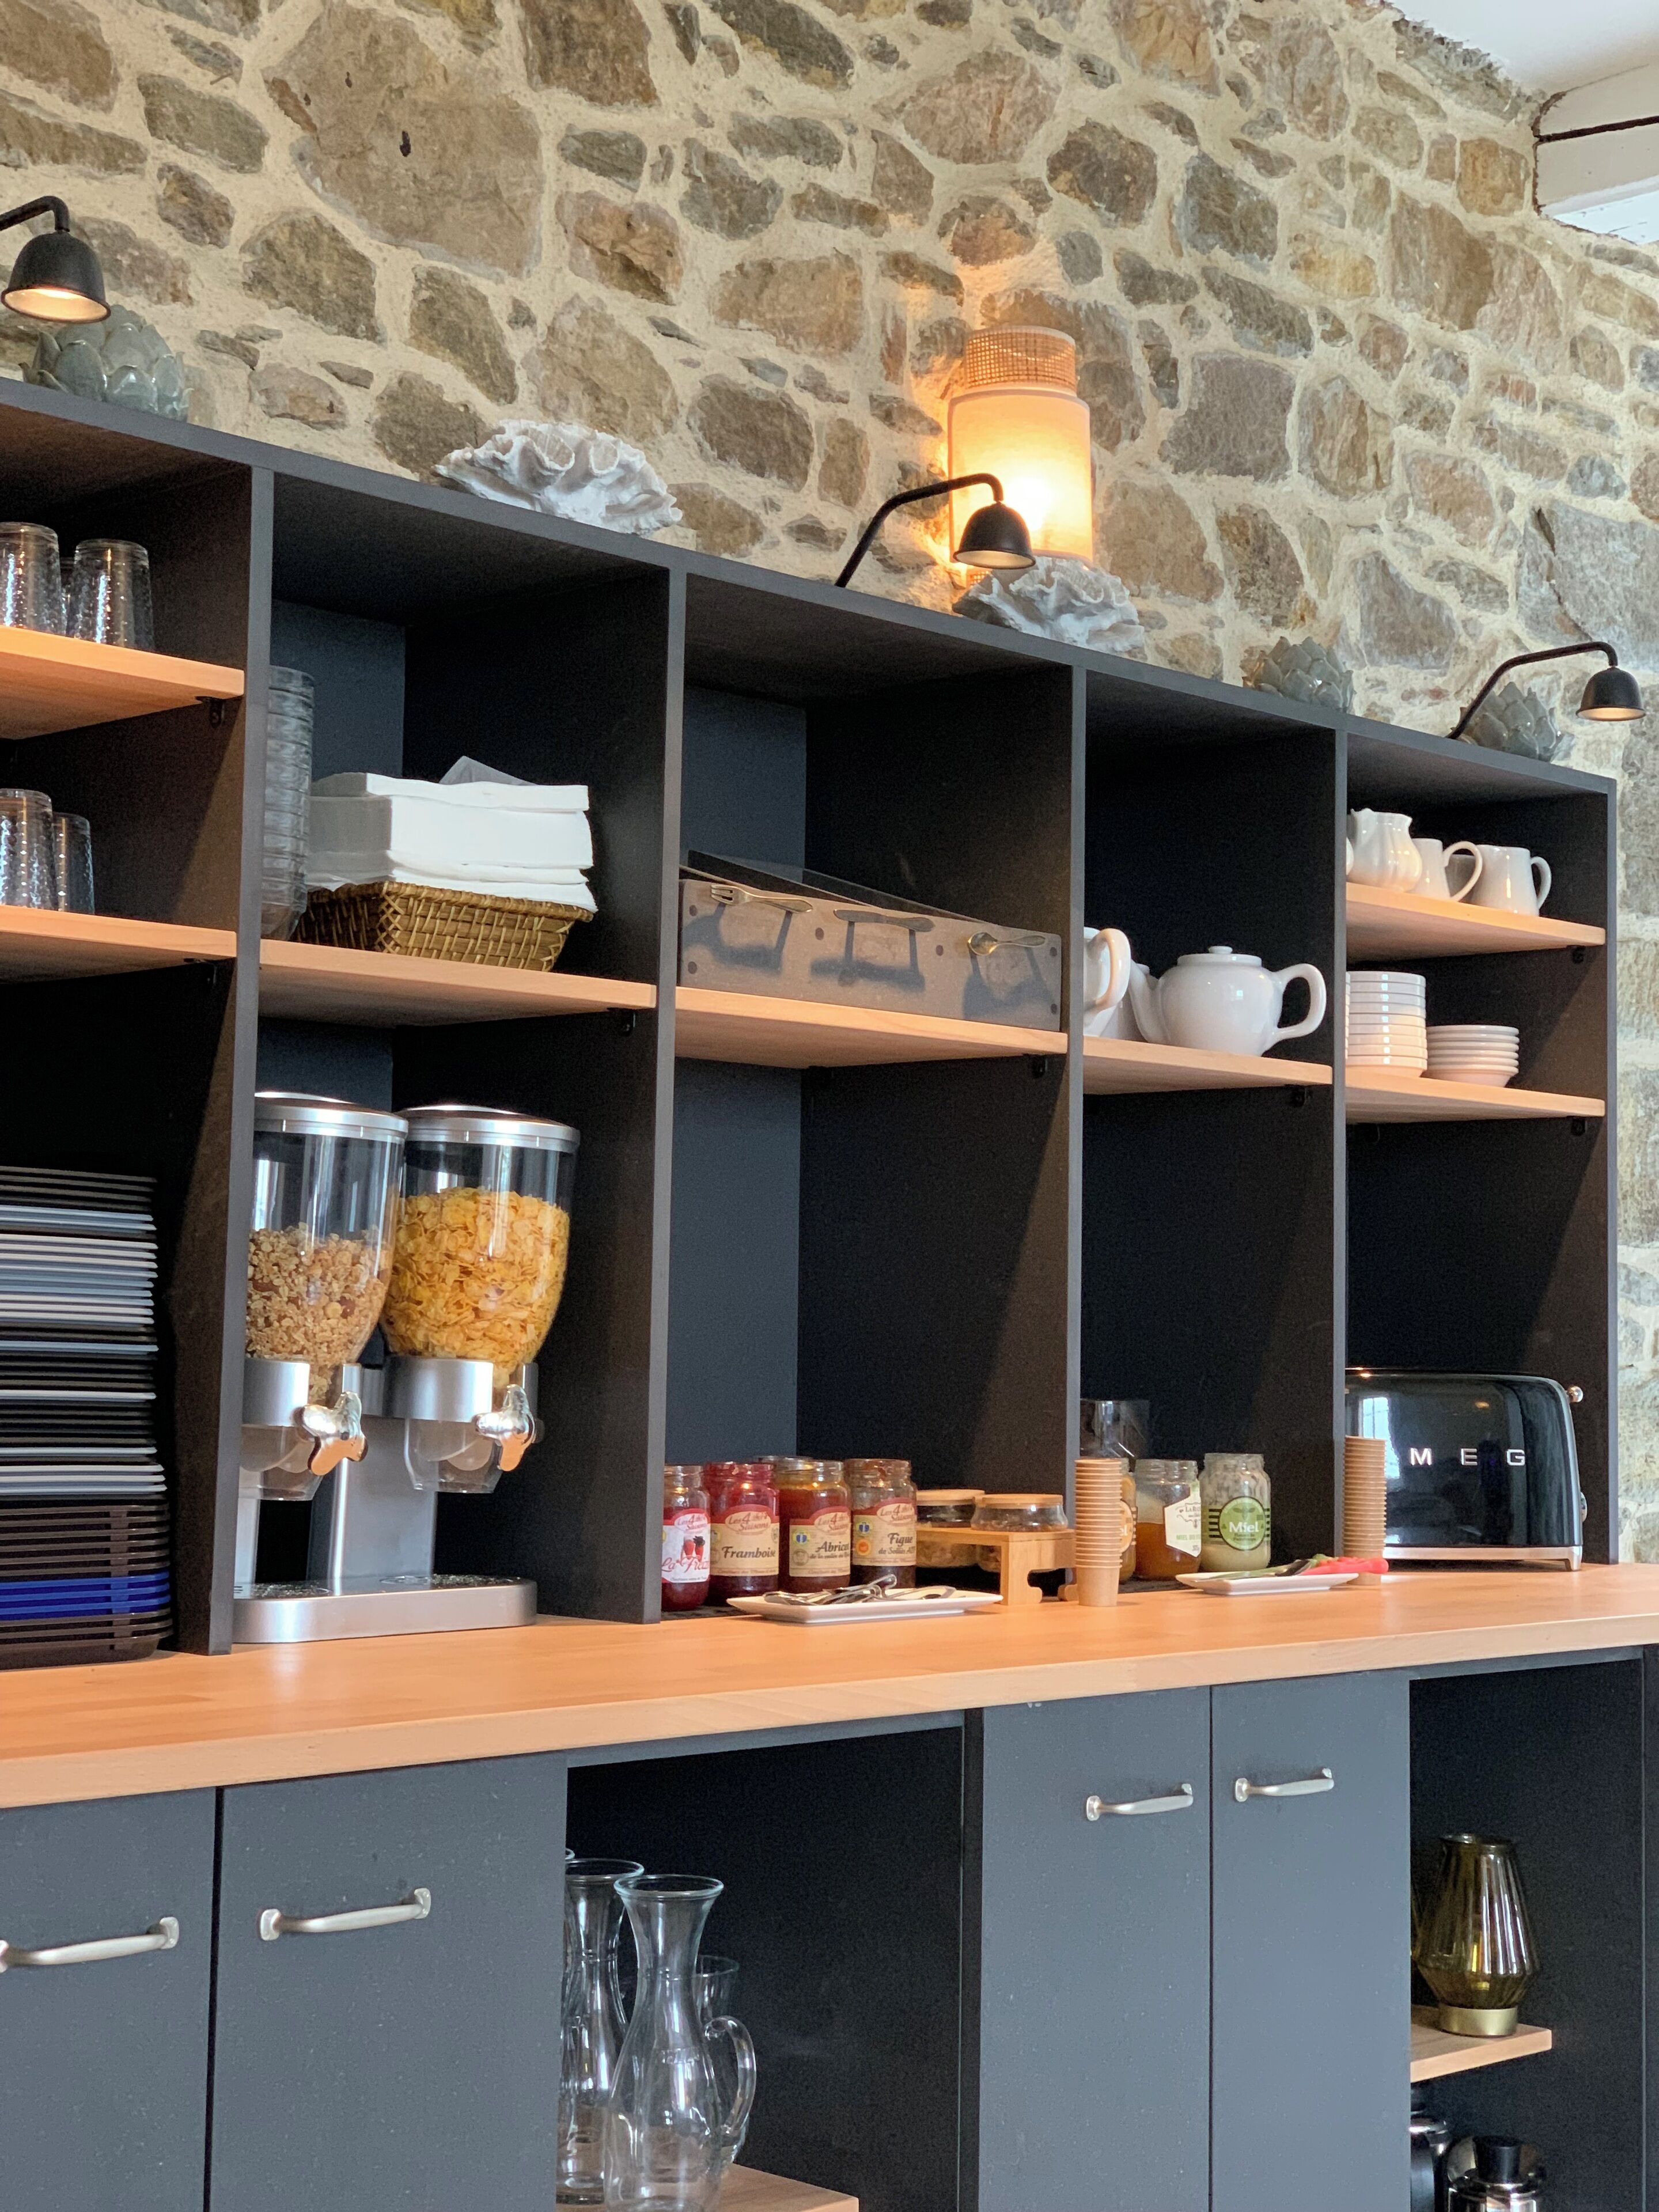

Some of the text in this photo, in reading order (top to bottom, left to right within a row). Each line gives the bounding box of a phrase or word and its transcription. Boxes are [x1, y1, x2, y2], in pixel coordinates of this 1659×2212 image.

[1410, 1448, 1526, 1466] MEG
[893, 1504, 901, 1516] 4
[688, 1514, 695, 1524] 4
[741, 1512, 751, 1524] 4
[830, 1513, 838, 1525] 4
[1229, 1521, 1259, 1532] Miel
[887, 1532, 913, 1547] Figue
[721, 1546, 776, 1559] Framboise
